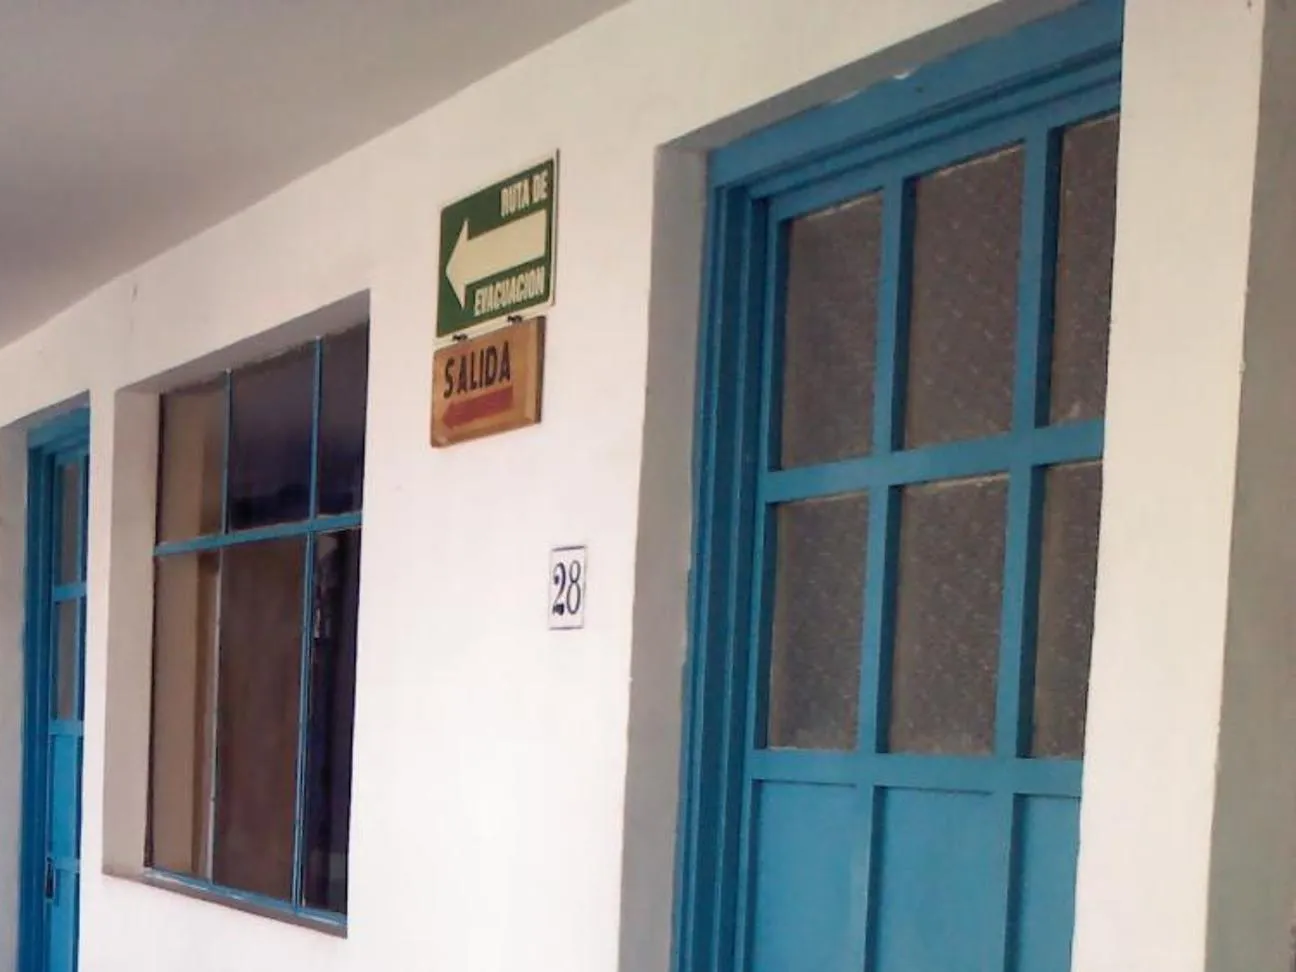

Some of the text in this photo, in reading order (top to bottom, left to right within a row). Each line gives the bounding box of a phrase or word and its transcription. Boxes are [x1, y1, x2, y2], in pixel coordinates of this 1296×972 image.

[531, 170, 548, 202] DE
[474, 267, 545, 317] EVACUACION
[443, 341, 511, 399] SALIDA
[552, 559, 582, 616] 28
